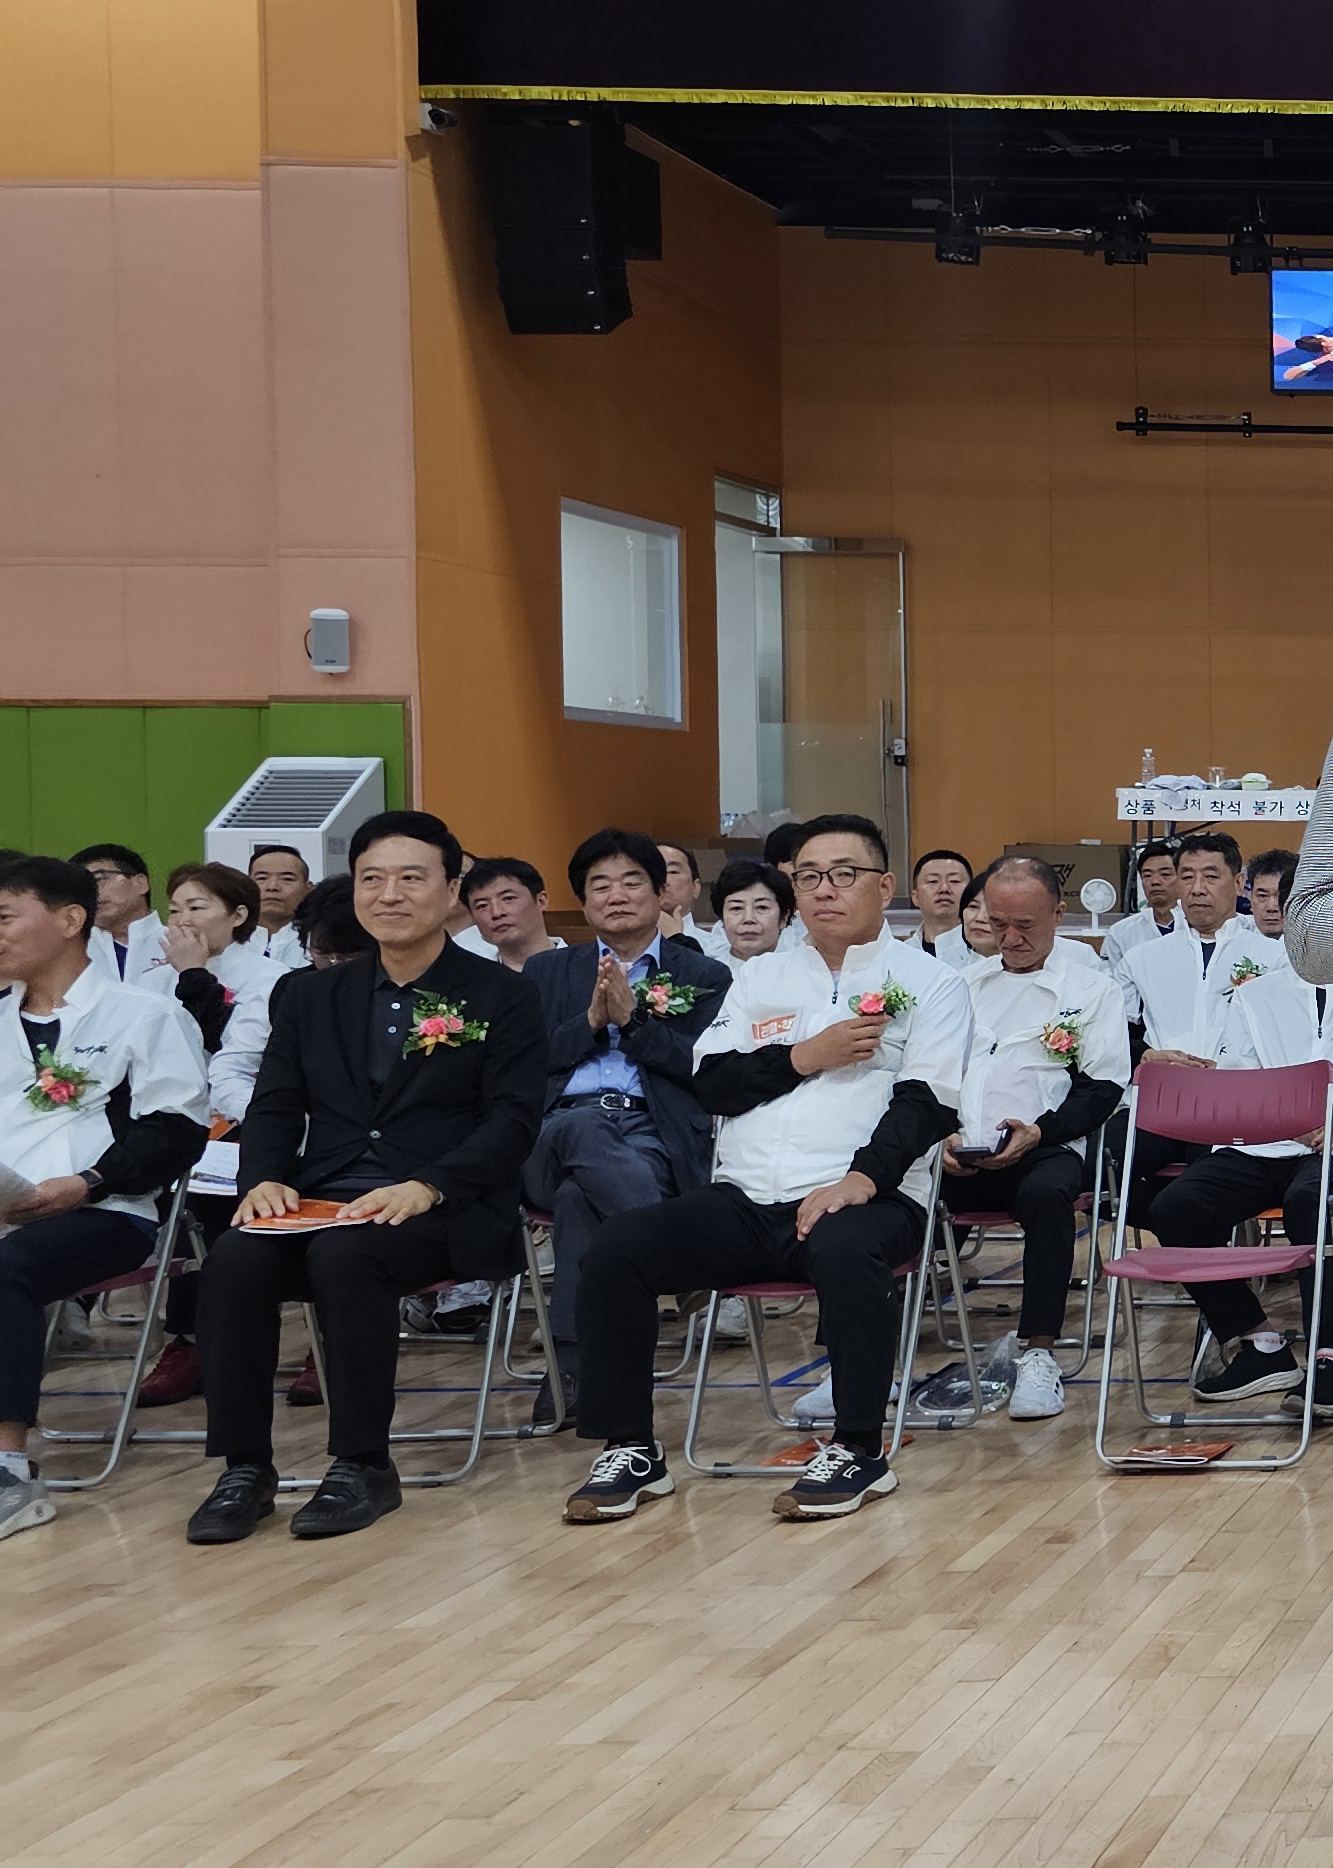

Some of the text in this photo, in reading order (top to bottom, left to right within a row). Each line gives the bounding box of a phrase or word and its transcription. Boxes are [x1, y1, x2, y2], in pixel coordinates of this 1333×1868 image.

[1124, 799, 1157, 816] 상품
[1209, 800, 1242, 817] 착석
[1252, 800, 1285, 817] 불가
[1295, 800, 1311, 816] 상
